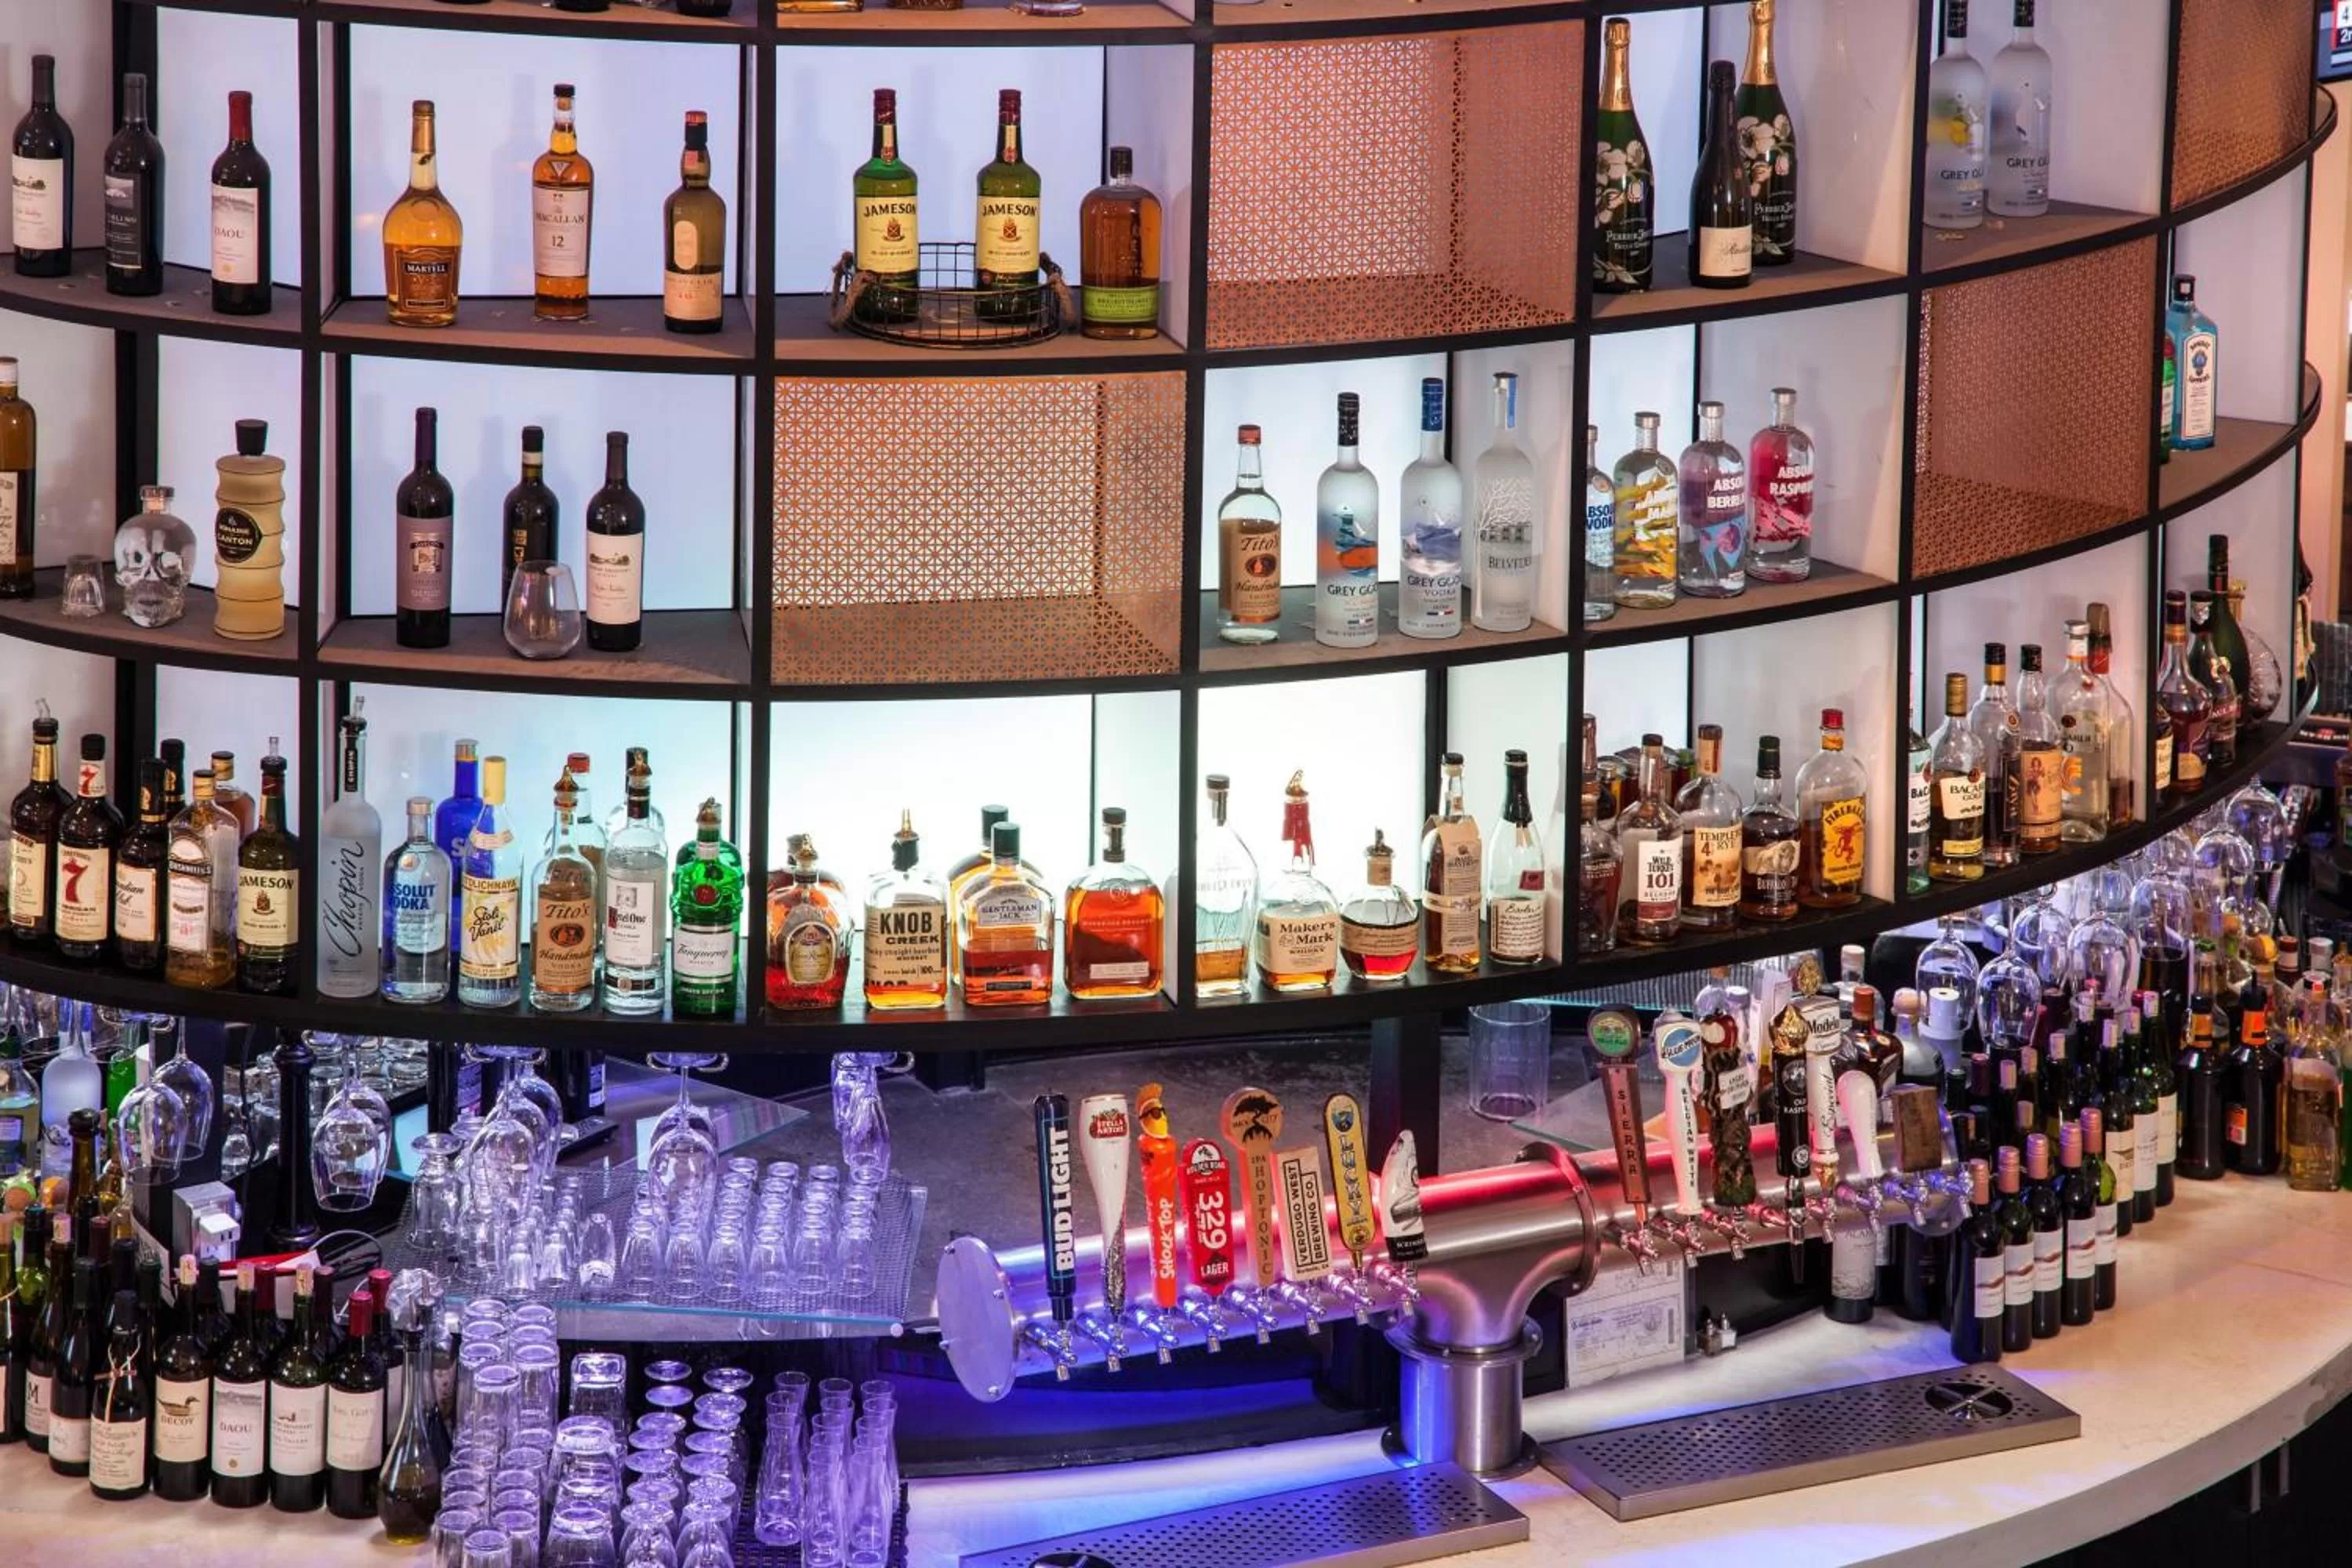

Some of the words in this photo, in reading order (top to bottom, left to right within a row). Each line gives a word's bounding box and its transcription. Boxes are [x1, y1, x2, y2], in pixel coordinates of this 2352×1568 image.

[2006, 158, 2036, 168] GREY
[1941, 169, 1969, 180] GREY
[982, 203, 1037, 217] JAMESON
[552, 235, 564, 248] 12
[407, 263, 445, 273] MARTELL
[1407, 575, 1434, 586] GREY
[1327, 584, 1356, 596] GREY
[63, 860, 89, 904] 7
[1646, 873, 1674, 888] 101
[321, 840, 372, 958] Chopin
[546, 903, 590, 920] Tito's
[982, 904, 1038, 913] GENTLEMAN
[880, 912, 932, 935] KNOB
[1279, 921, 1335, 933] Maker's
[885, 935, 940, 945] CREEK
[1296, 932, 1334, 944] Mark
[677, 944, 728, 960] Tanqueray
[1618, 1091, 1636, 1174] SIERRA
[1050, 1127, 1072, 1209] LIGHT
[1288, 1166, 1300, 1200] WEST
[1159, 1199, 1174, 1228] TOP
[1199, 1191, 1227, 1249] 329
[1293, 1203, 1308, 1262] VERDUGO
[1308, 1203, 1324, 1259] BREWING
[1054, 1212, 1074, 1272] BUD
[1160, 1231, 1174, 1279] SHOCK
[1200, 1262, 1229, 1277] LAGER
[161, 1416, 195, 1425] DECOY
[220, 1421, 252, 1432] DAOU
